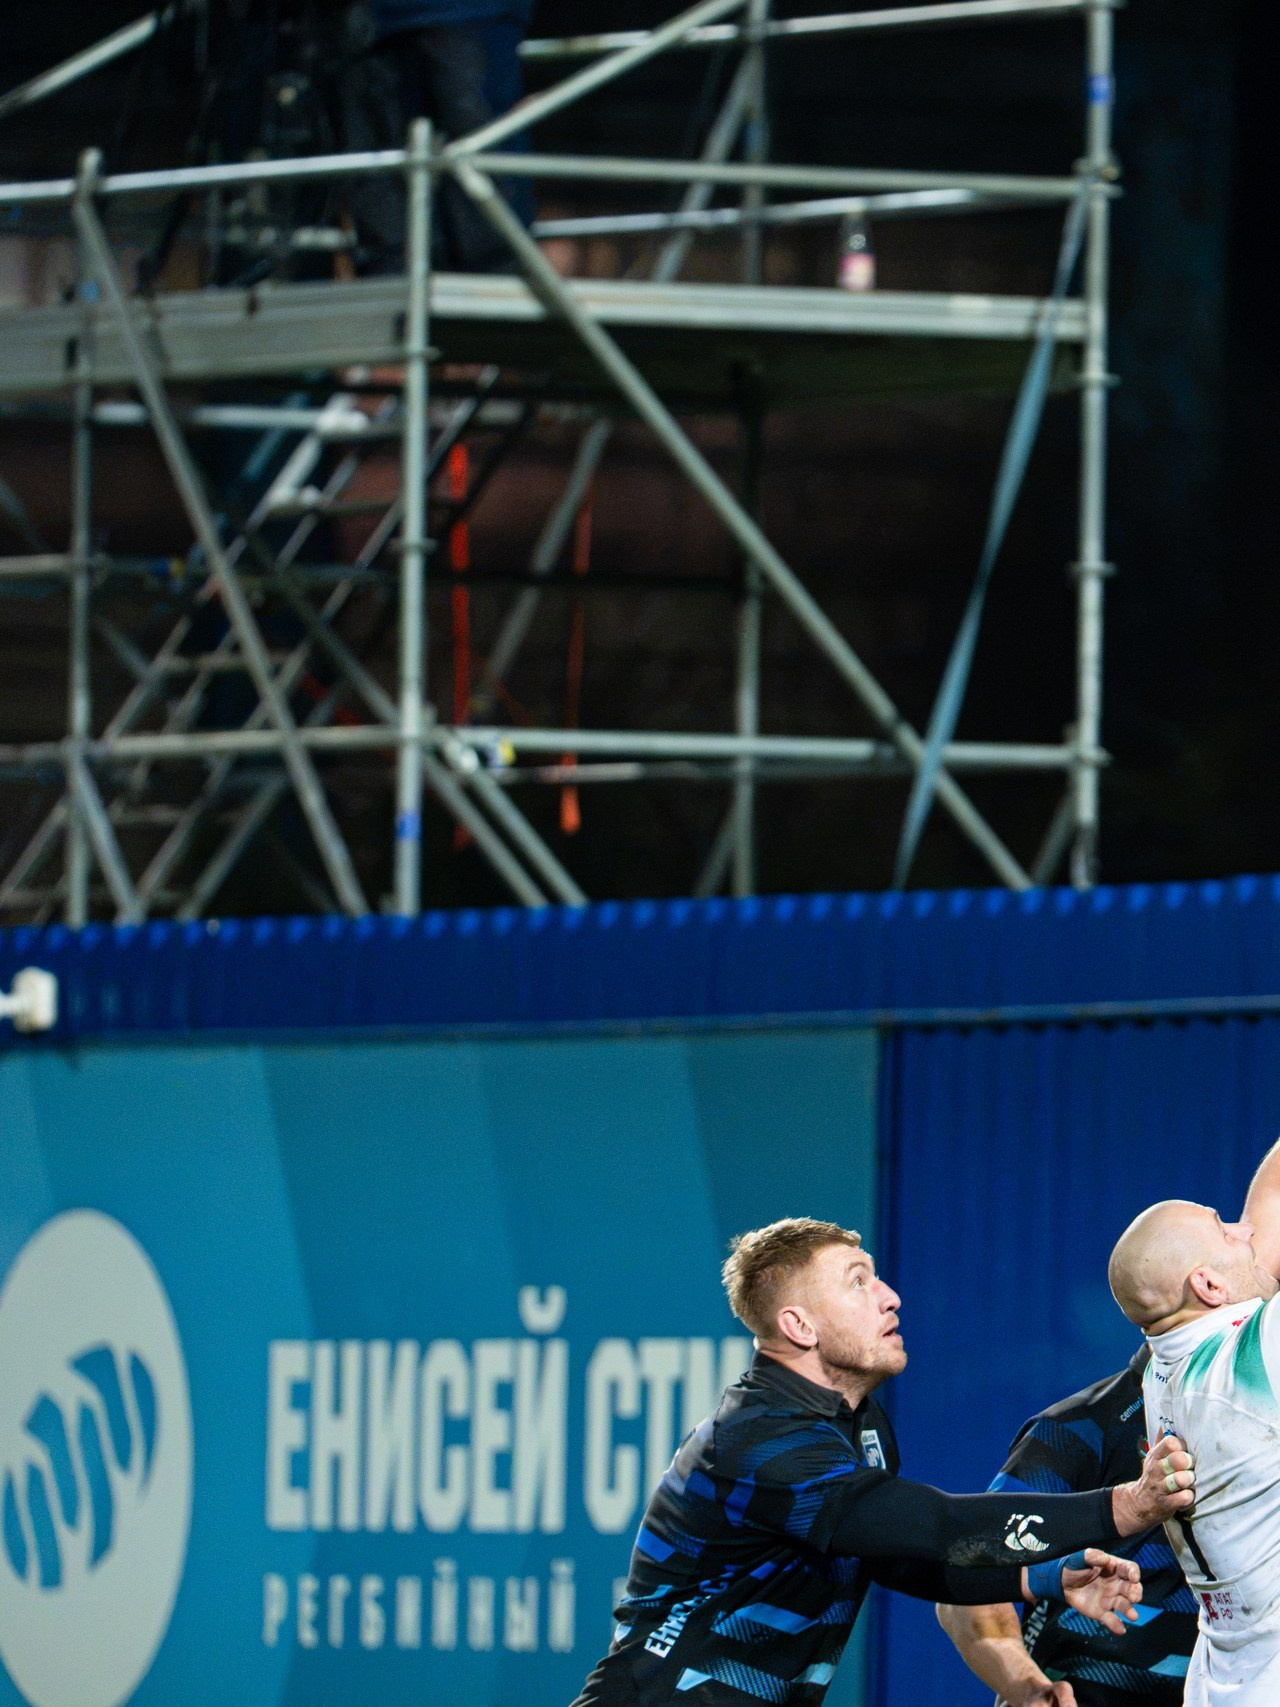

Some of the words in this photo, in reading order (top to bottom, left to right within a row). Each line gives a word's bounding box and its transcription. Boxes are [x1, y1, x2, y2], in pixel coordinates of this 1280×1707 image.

[265, 1285, 570, 1535] ЕНИСЕЙ
[1120, 1396, 1145, 1423] centuri
[261, 1556, 577, 1654] РЕГБИЙНЫЙ
